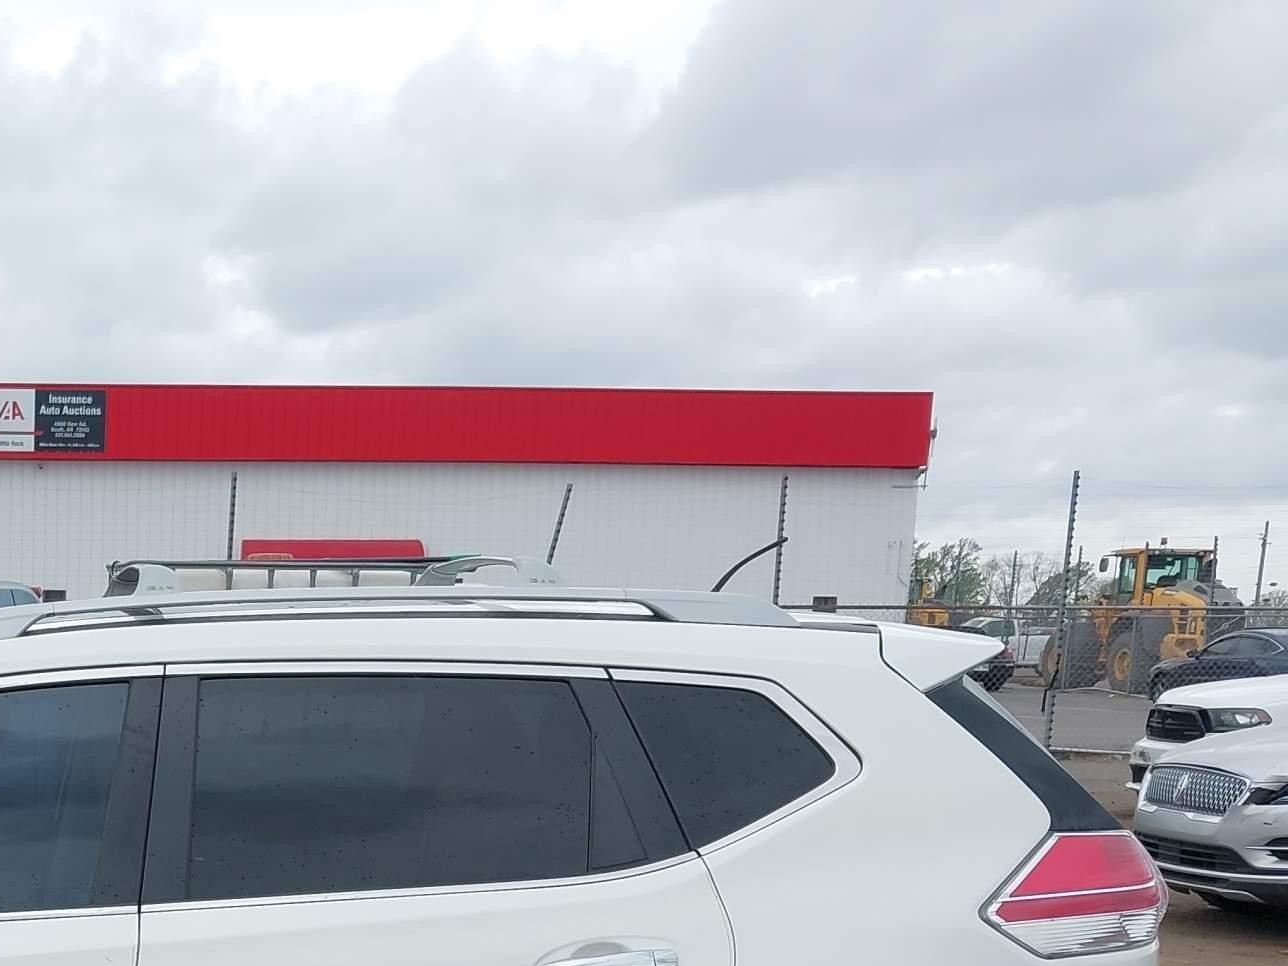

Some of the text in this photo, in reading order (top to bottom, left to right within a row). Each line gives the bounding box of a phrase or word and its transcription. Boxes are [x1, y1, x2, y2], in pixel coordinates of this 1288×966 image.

[48, 394, 93, 404] Insurance
[39, 405, 102, 415] Auto Auctions
